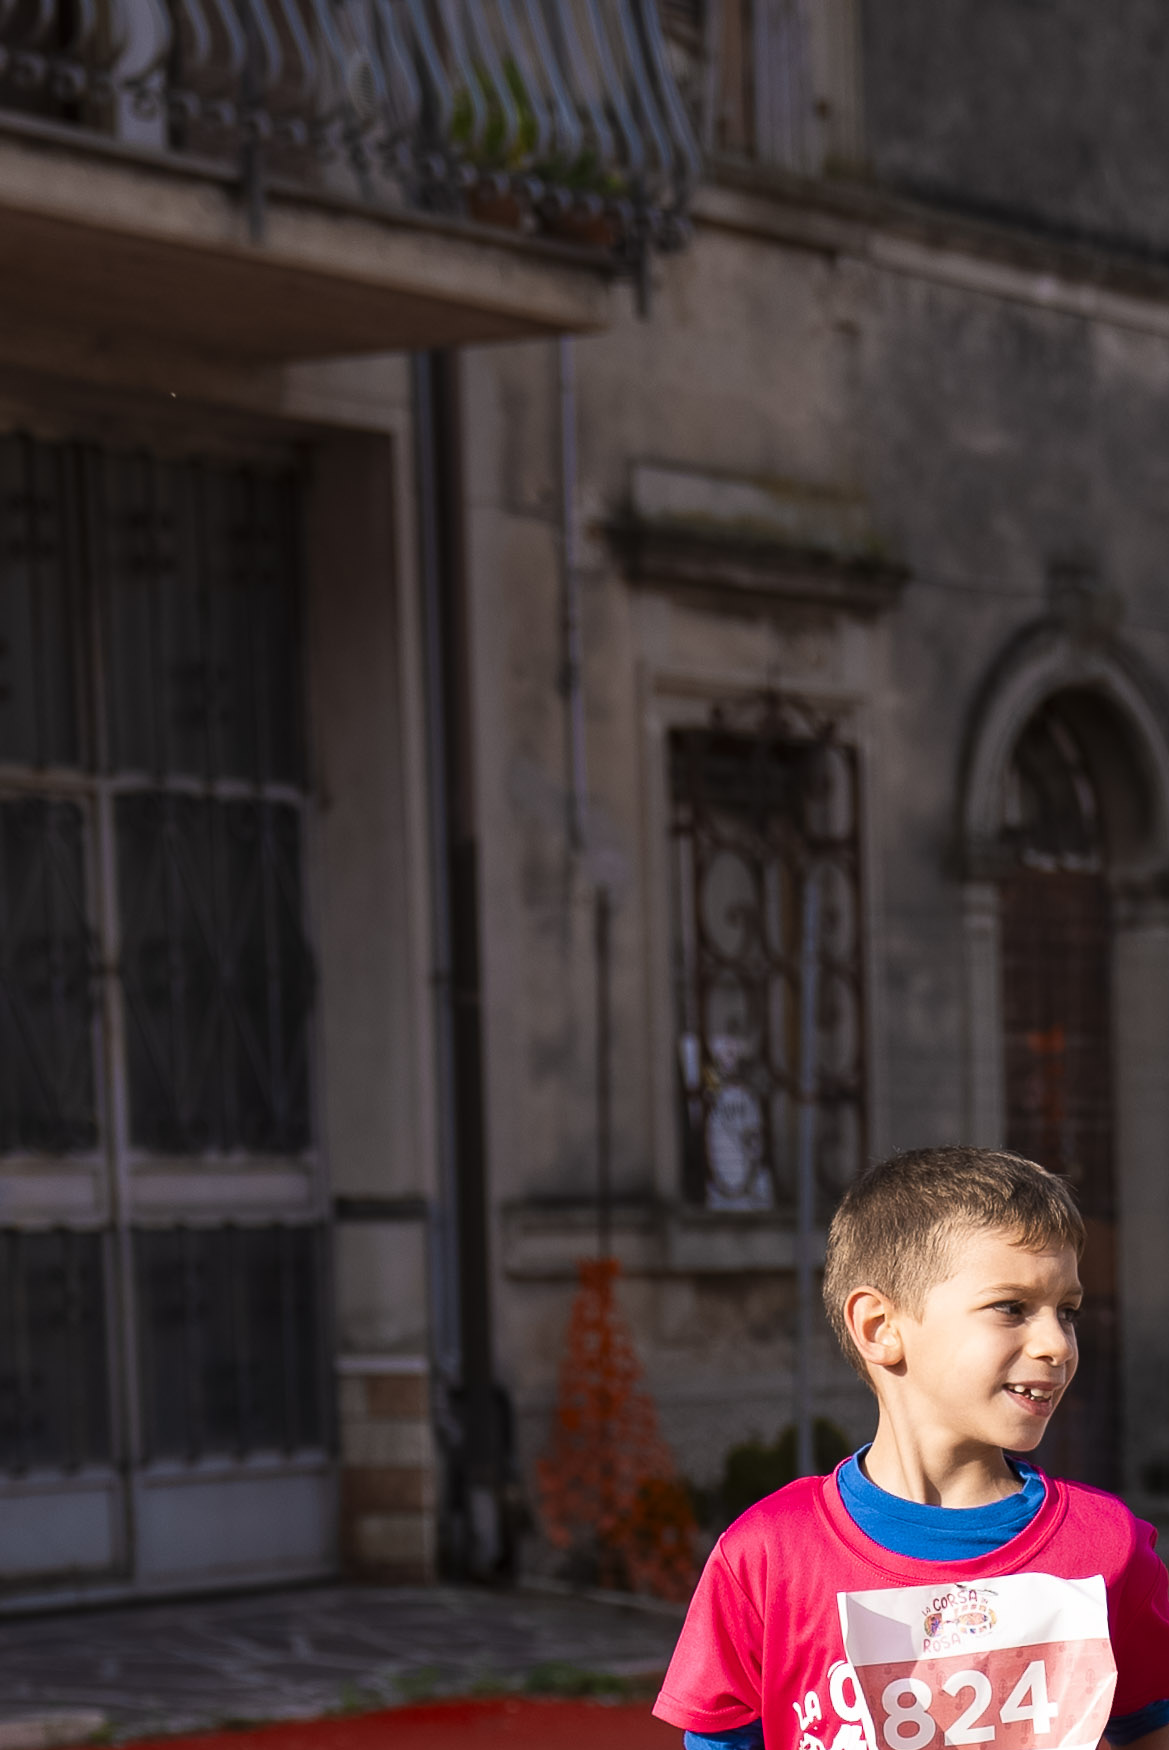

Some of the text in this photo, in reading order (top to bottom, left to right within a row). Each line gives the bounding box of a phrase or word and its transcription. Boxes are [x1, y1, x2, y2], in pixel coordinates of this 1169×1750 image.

[933, 1589, 978, 1612] CORSA
[923, 1633, 961, 1653] ROSA
[792, 1691, 822, 1731] LA
